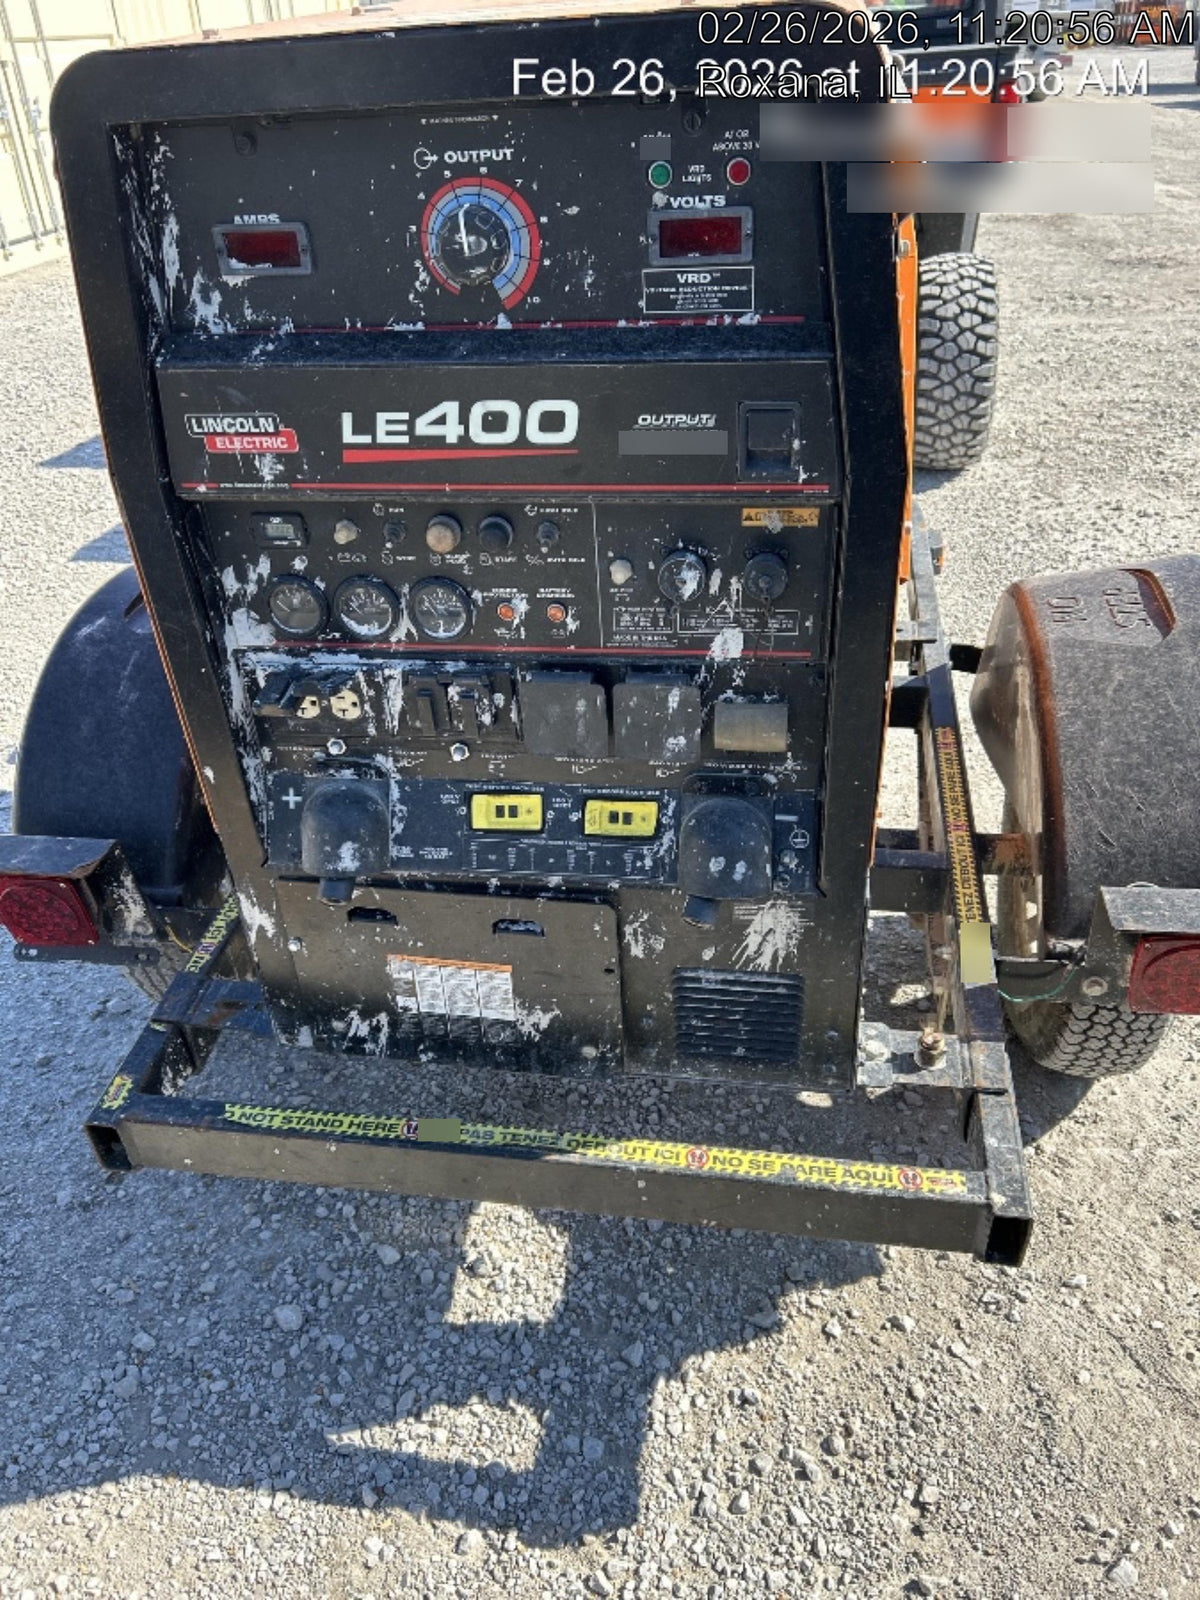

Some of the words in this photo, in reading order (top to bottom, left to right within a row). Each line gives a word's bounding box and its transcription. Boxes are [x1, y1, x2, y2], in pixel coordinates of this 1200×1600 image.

[443, 148, 515, 164] OUTPUT
[514, 179, 524, 187] 7
[669, 194, 726, 208] VOLTS
[190, 416, 276, 434] LINCOLN
[341, 399, 579, 445] LE400
[636, 413, 713, 426] OUTPUT
[214, 436, 289, 450] ELECTRIC
[238, 1111, 280, 1126] NOT
[280, 1113, 344, 1130] STAND
[345, 1119, 401, 1134] HERE
[653, 1146, 681, 1162] ICI
[711, 1154, 743, 1168] NO
[747, 1158, 777, 1172] SE
